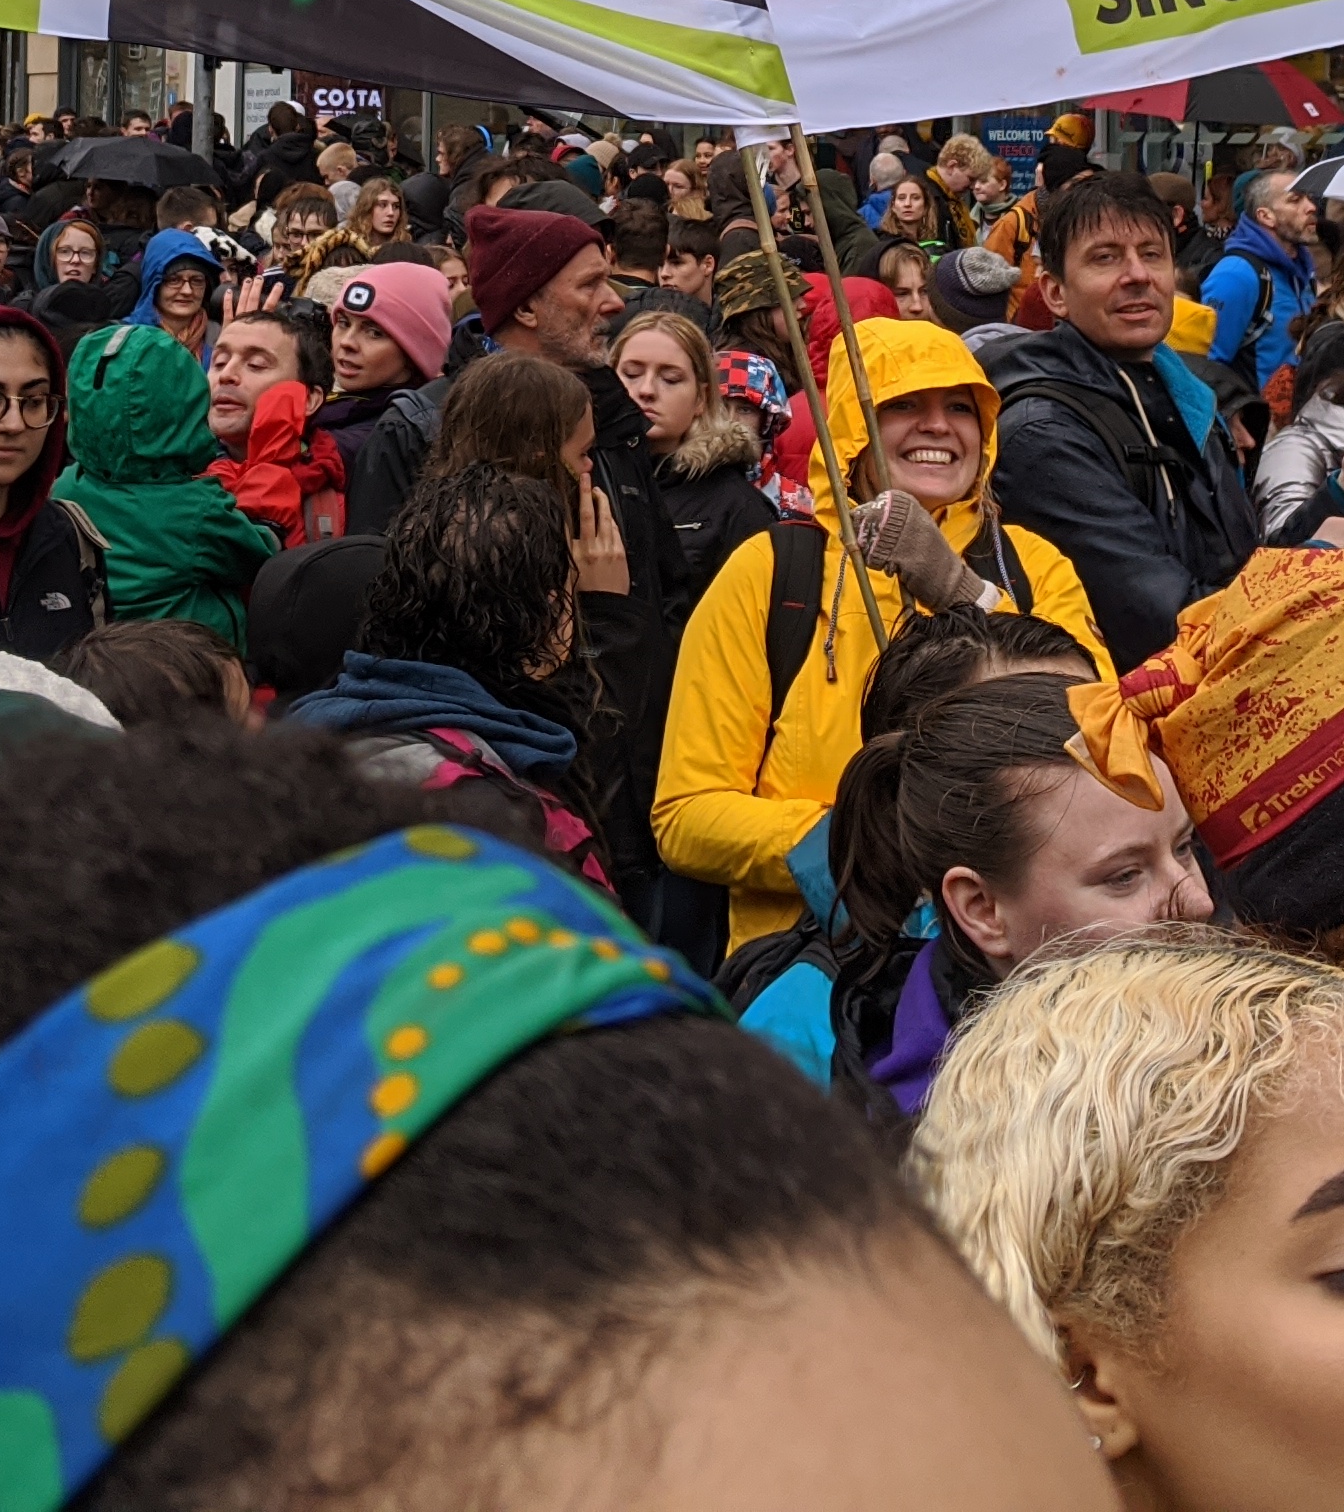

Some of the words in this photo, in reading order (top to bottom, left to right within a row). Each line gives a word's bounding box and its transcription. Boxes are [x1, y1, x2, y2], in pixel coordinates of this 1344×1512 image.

[313, 88, 382, 109] COSTA
[989, 129, 1031, 141] WELCOME
[1032, 129, 1044, 141] TO
[997, 144, 1035, 157] TESCO
